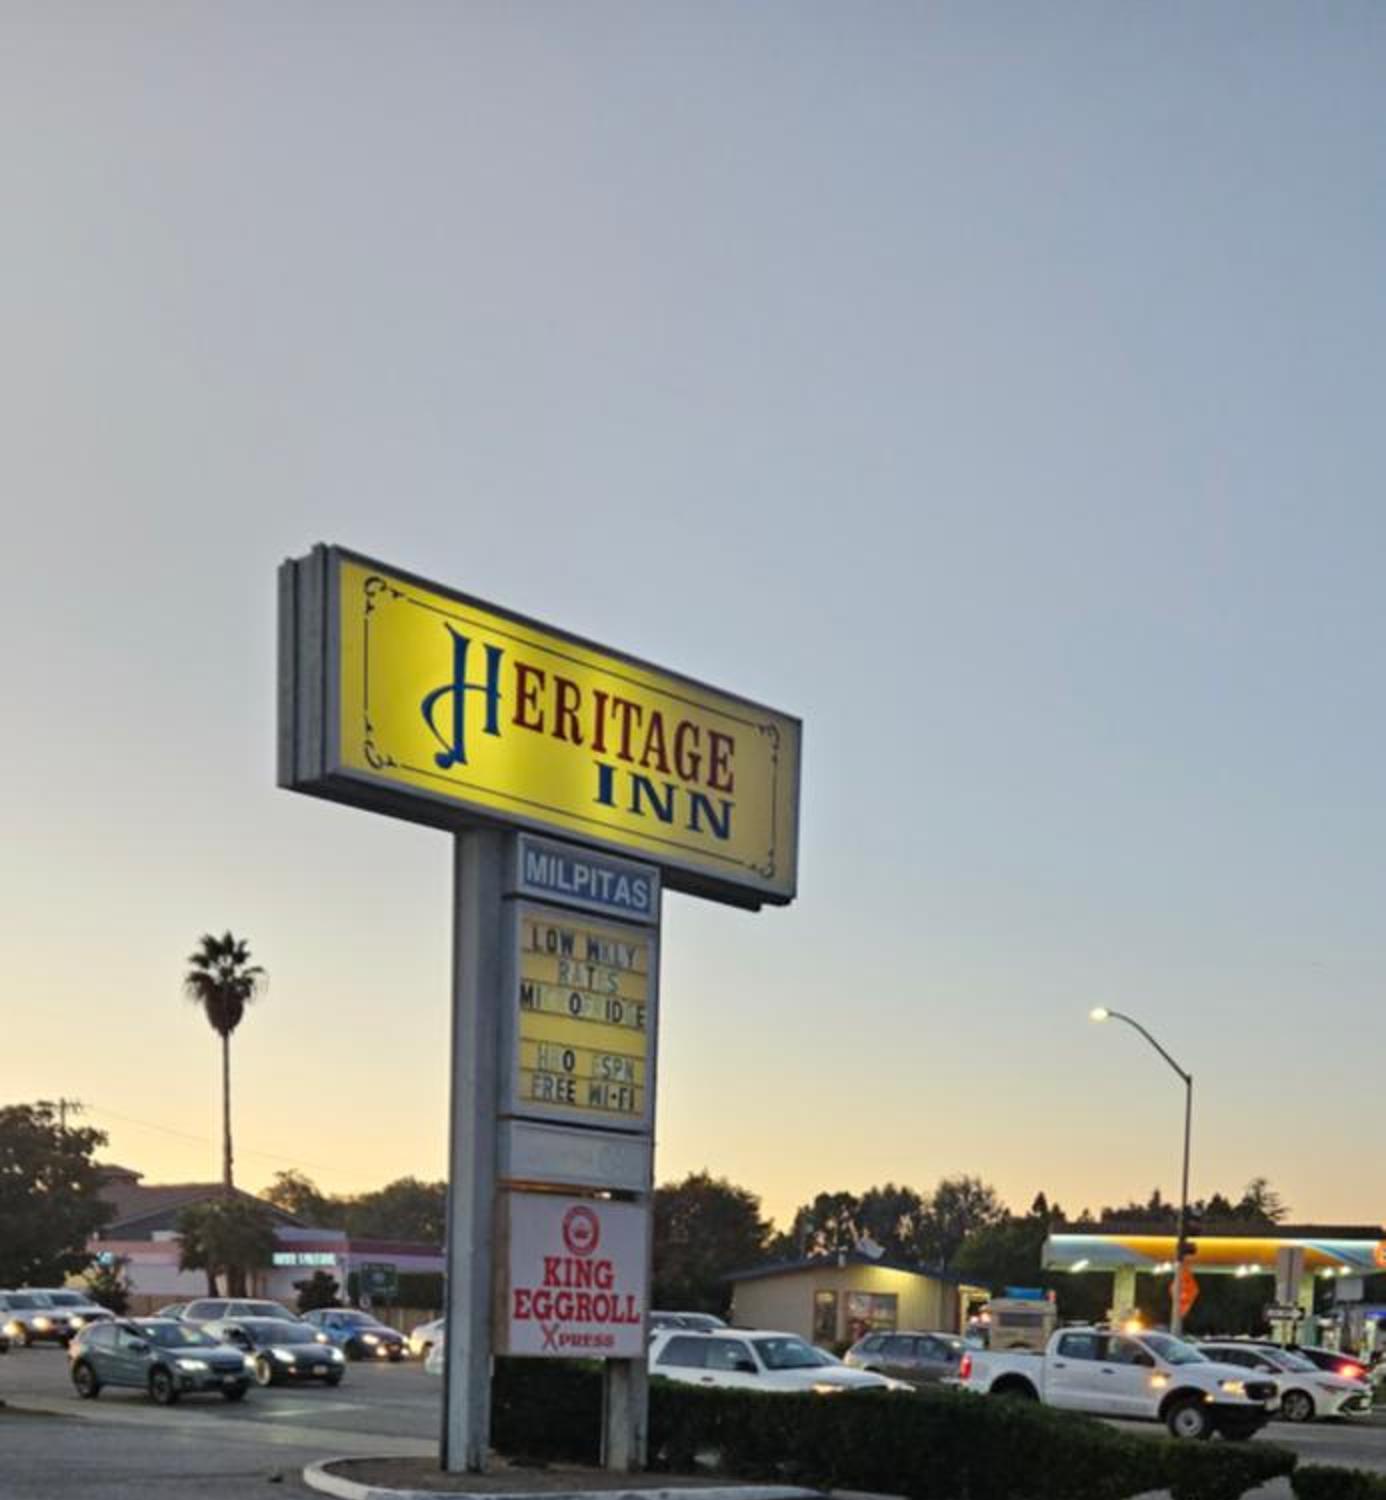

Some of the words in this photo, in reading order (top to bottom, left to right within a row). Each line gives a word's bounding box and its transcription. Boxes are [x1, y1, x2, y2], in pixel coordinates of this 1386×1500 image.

[420, 621, 735, 794] HERITAGE
[592, 759, 736, 841] INN
[526, 851, 648, 909] MILPITAS
[531, 925, 574, 959] LOW
[531, 1074, 576, 1103] FREE
[543, 1256, 614, 1290] KING
[513, 1288, 641, 1325] EGGROLL
